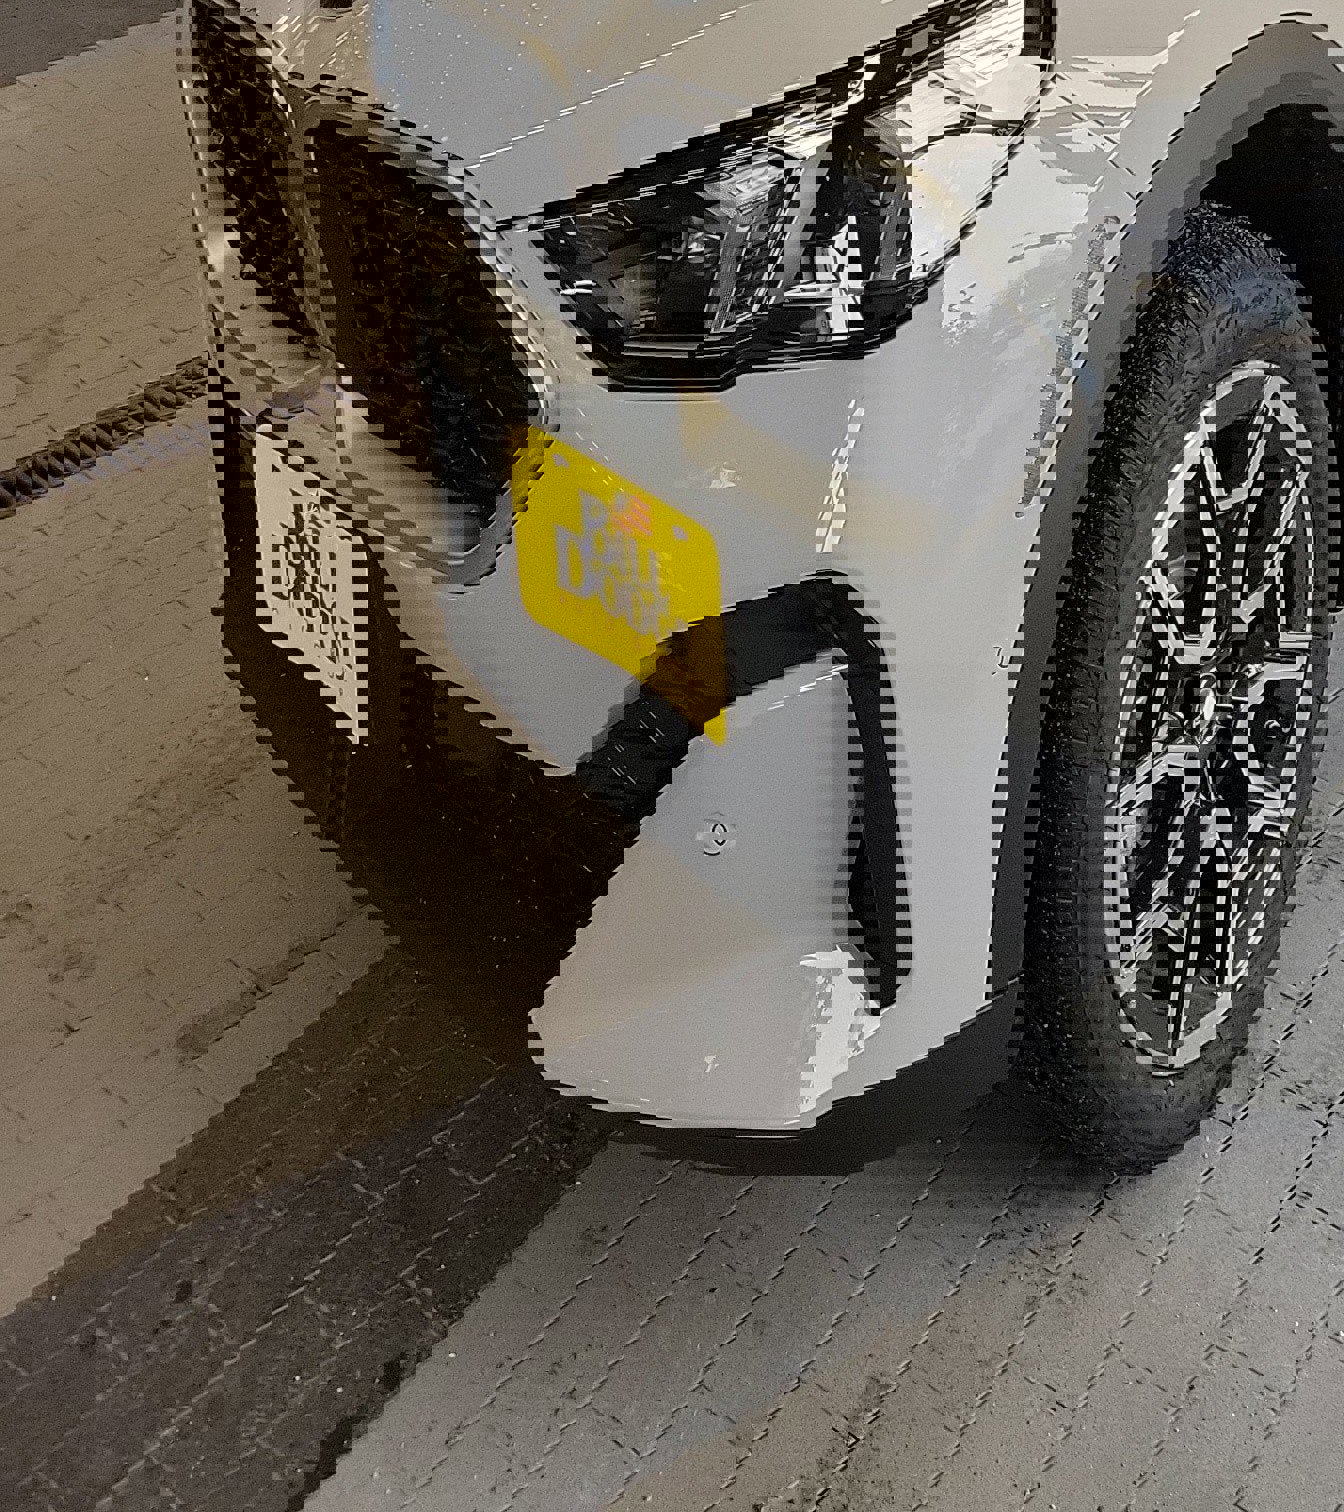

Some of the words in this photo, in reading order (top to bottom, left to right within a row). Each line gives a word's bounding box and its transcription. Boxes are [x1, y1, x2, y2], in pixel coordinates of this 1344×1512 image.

[551, 522, 697, 677] DODGE
[577, 488, 670, 607] BILL
[559, 592, 614, 632] AUTO
[633, 635, 696, 691] GROUP
